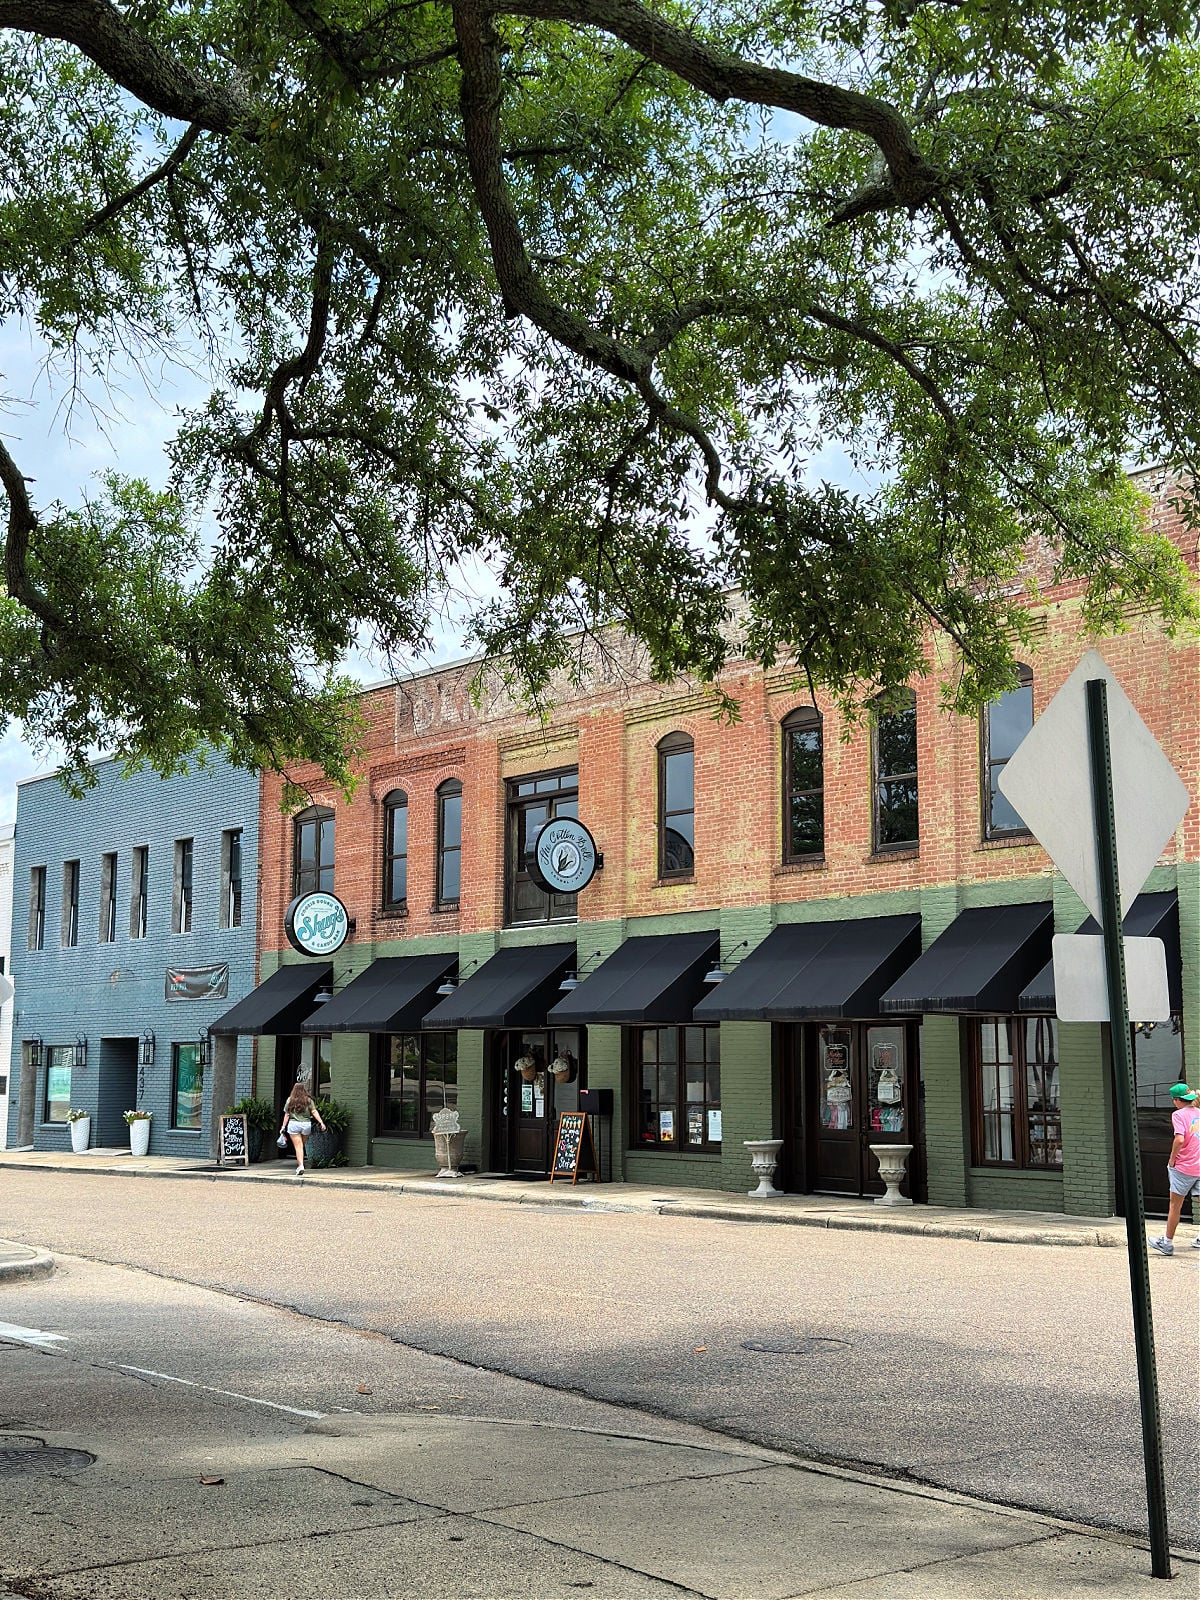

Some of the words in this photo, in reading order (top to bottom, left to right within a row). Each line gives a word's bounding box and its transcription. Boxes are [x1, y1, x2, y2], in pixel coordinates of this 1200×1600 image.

[540, 844, 551, 865] The
[550, 829, 575, 843] Cotton
[297, 905, 345, 941] Shug's
[301, 900, 316, 916] COOKIE
[316, 899, 334, 908] DOUGH
